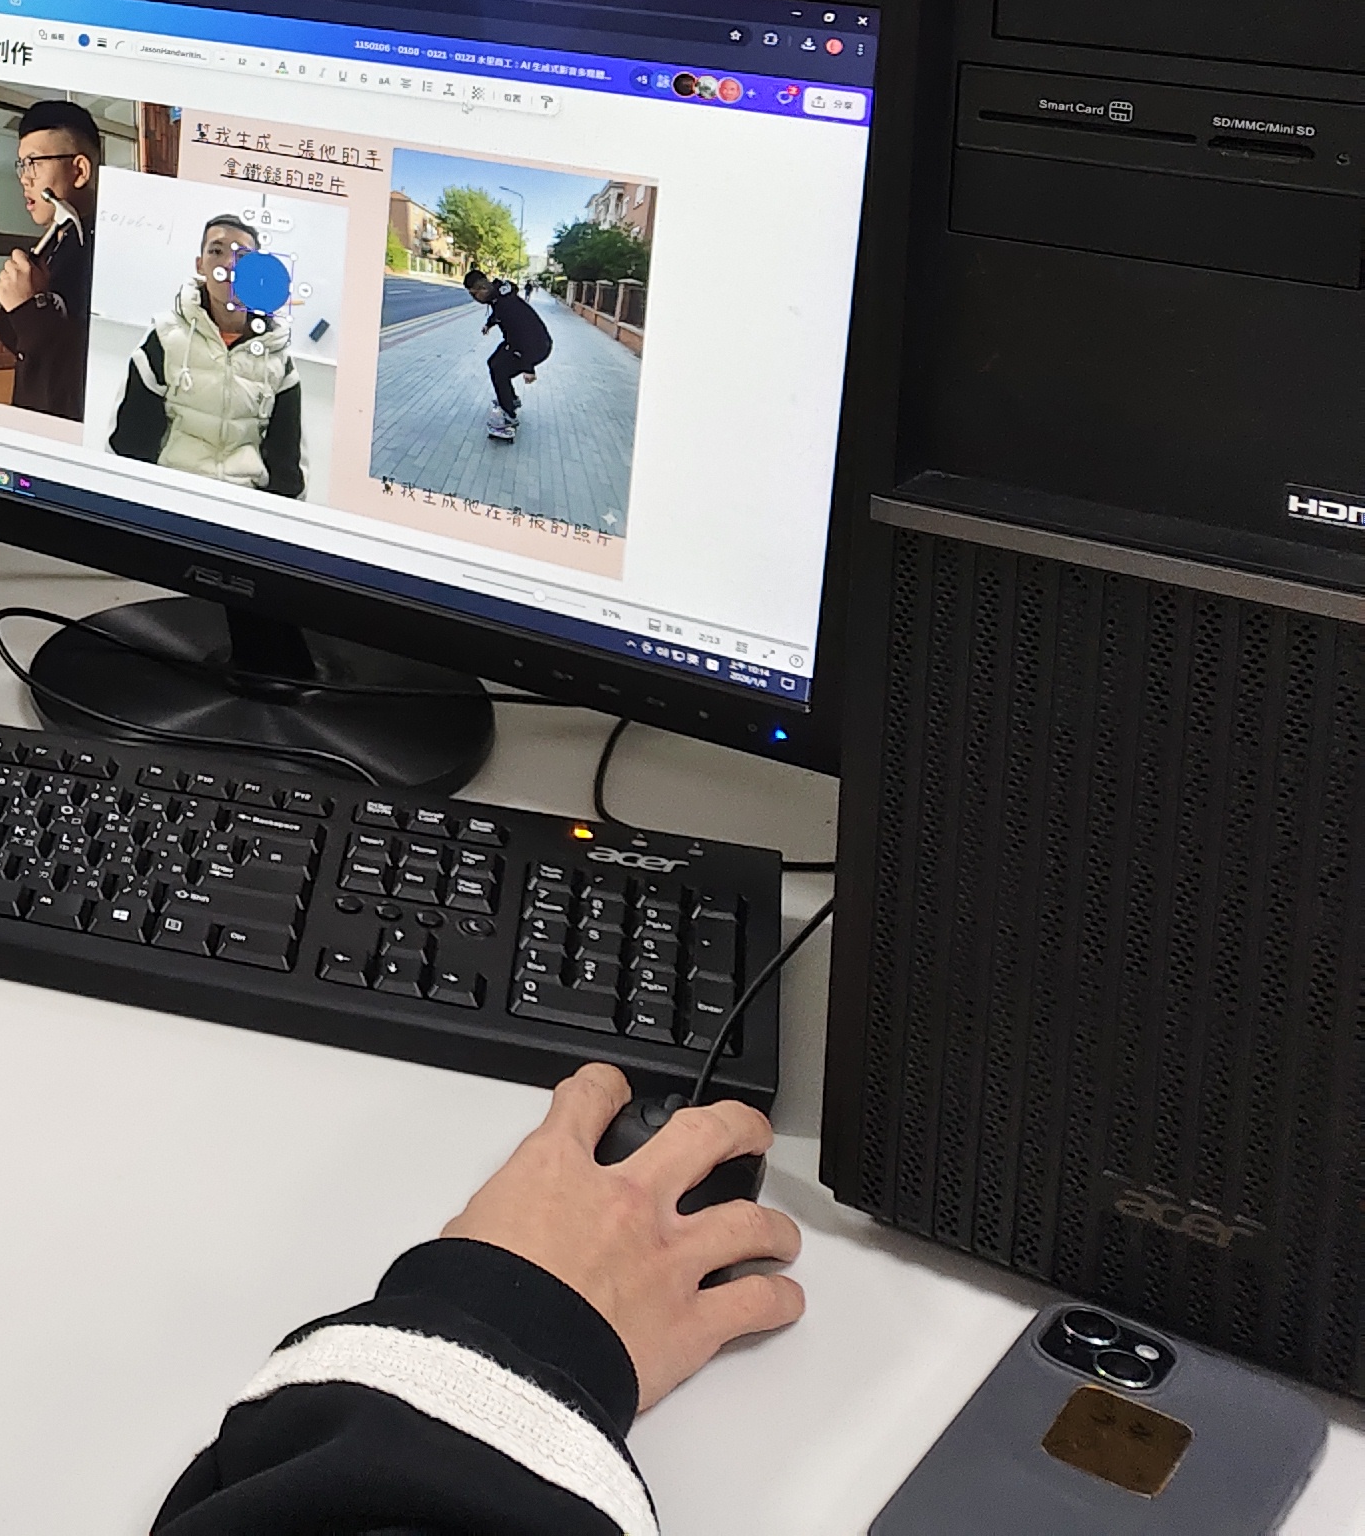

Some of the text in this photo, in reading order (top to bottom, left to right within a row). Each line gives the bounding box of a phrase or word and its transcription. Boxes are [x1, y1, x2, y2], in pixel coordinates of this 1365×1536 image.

[1038, 98, 1105, 117] Smart Card
[1212, 116, 1316, 138] SD/MMC/Mini SD
[183, 564, 255, 599] ASUS
[60, 805, 74, 814] O
[107, 813, 119, 822] P
[14, 826, 28, 836] K
[61, 833, 72, 843] L
[587, 846, 690, 873] acer
[538, 888, 550, 898] 7
[532, 919, 546, 929] 4
[588, 929, 600, 940] 5
[643, 939, 655, 950] 6
[641, 969, 654, 980] 3
[524, 980, 536, 991] 0
